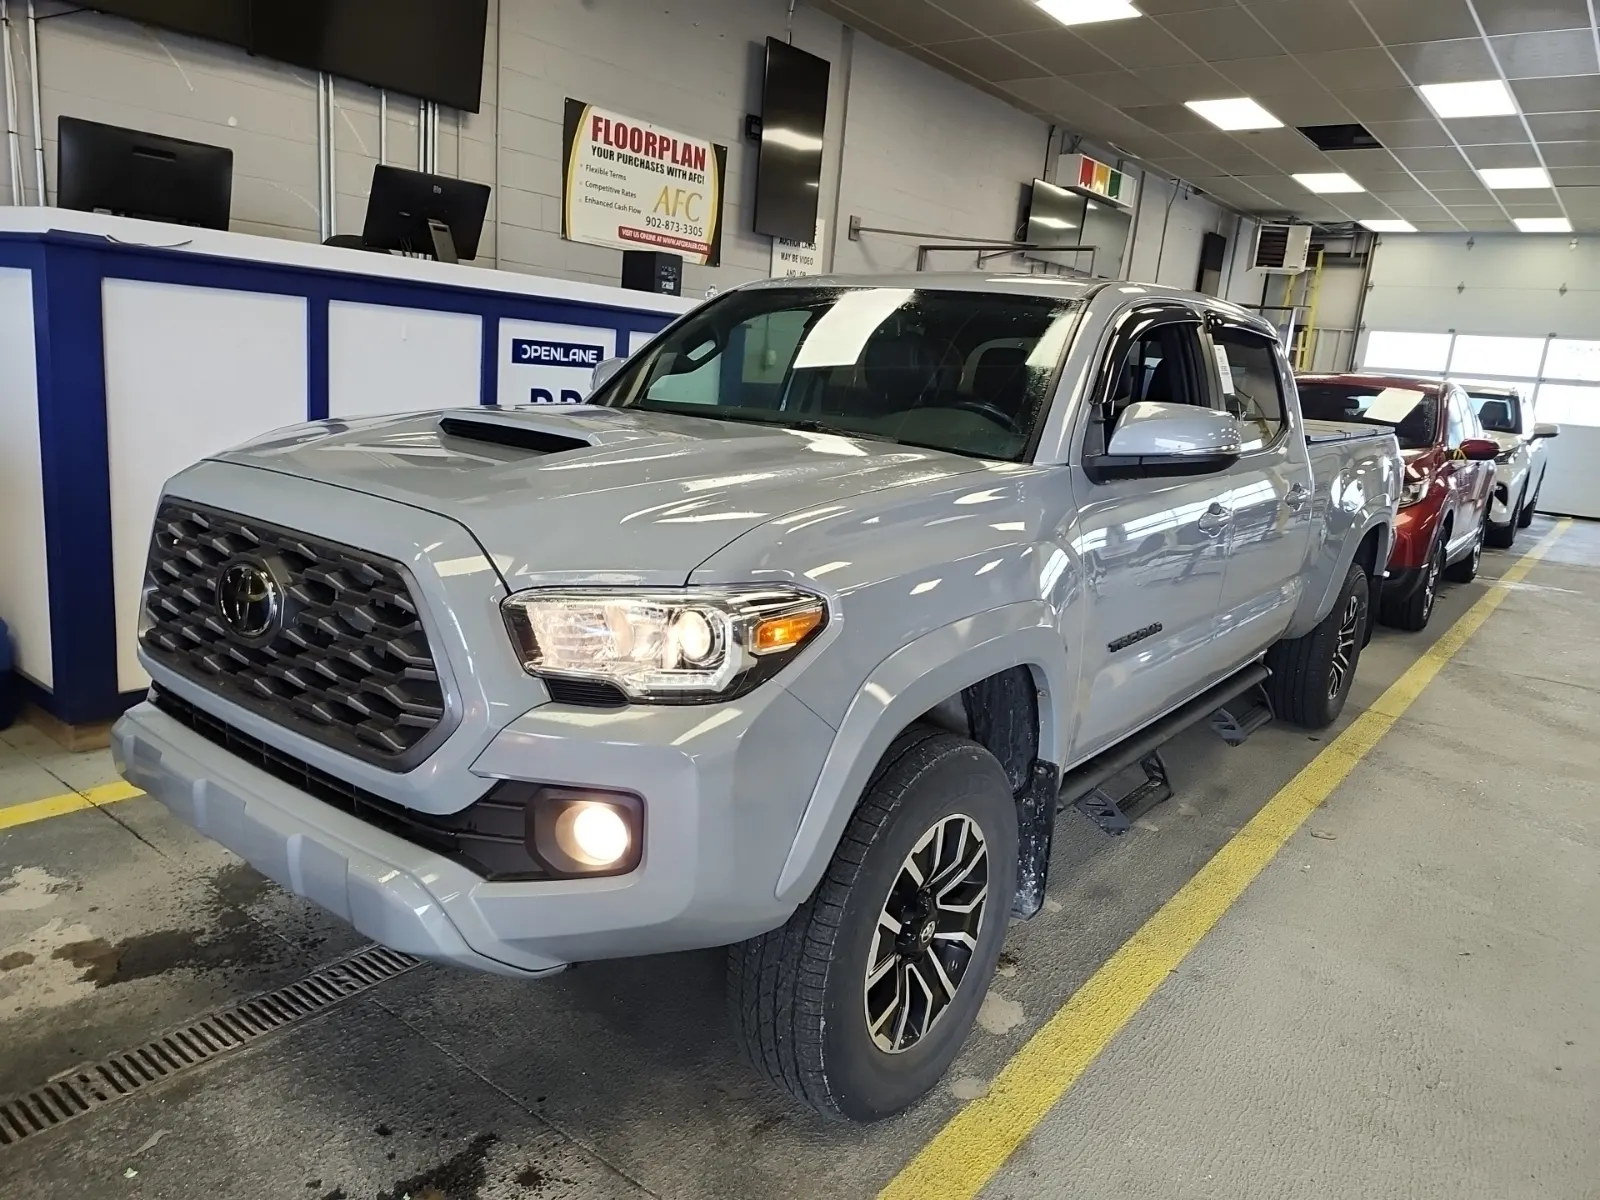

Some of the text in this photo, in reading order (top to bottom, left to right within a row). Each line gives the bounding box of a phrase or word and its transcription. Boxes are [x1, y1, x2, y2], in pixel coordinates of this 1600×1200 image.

[592, 115, 706, 172] FLOORPLAN
[586, 164, 626, 180] Flexible Terms
[592, 145, 705, 184] YOUR PURCHASES WITH AFC!
[585, 181, 636, 198] Competitive Rates
[585, 196, 642, 214] Enhanced Cash Flow
[653, 186, 702, 222] AFC
[646, 216, 702, 237] 902-873-3305
[622, 229, 632, 238] VISIT
[640, 232, 656, 242] ONLINE
[781, 252, 791, 260] MAY
[800, 256, 813, 266] VIDEO
[786, 269, 796, 277] AND
